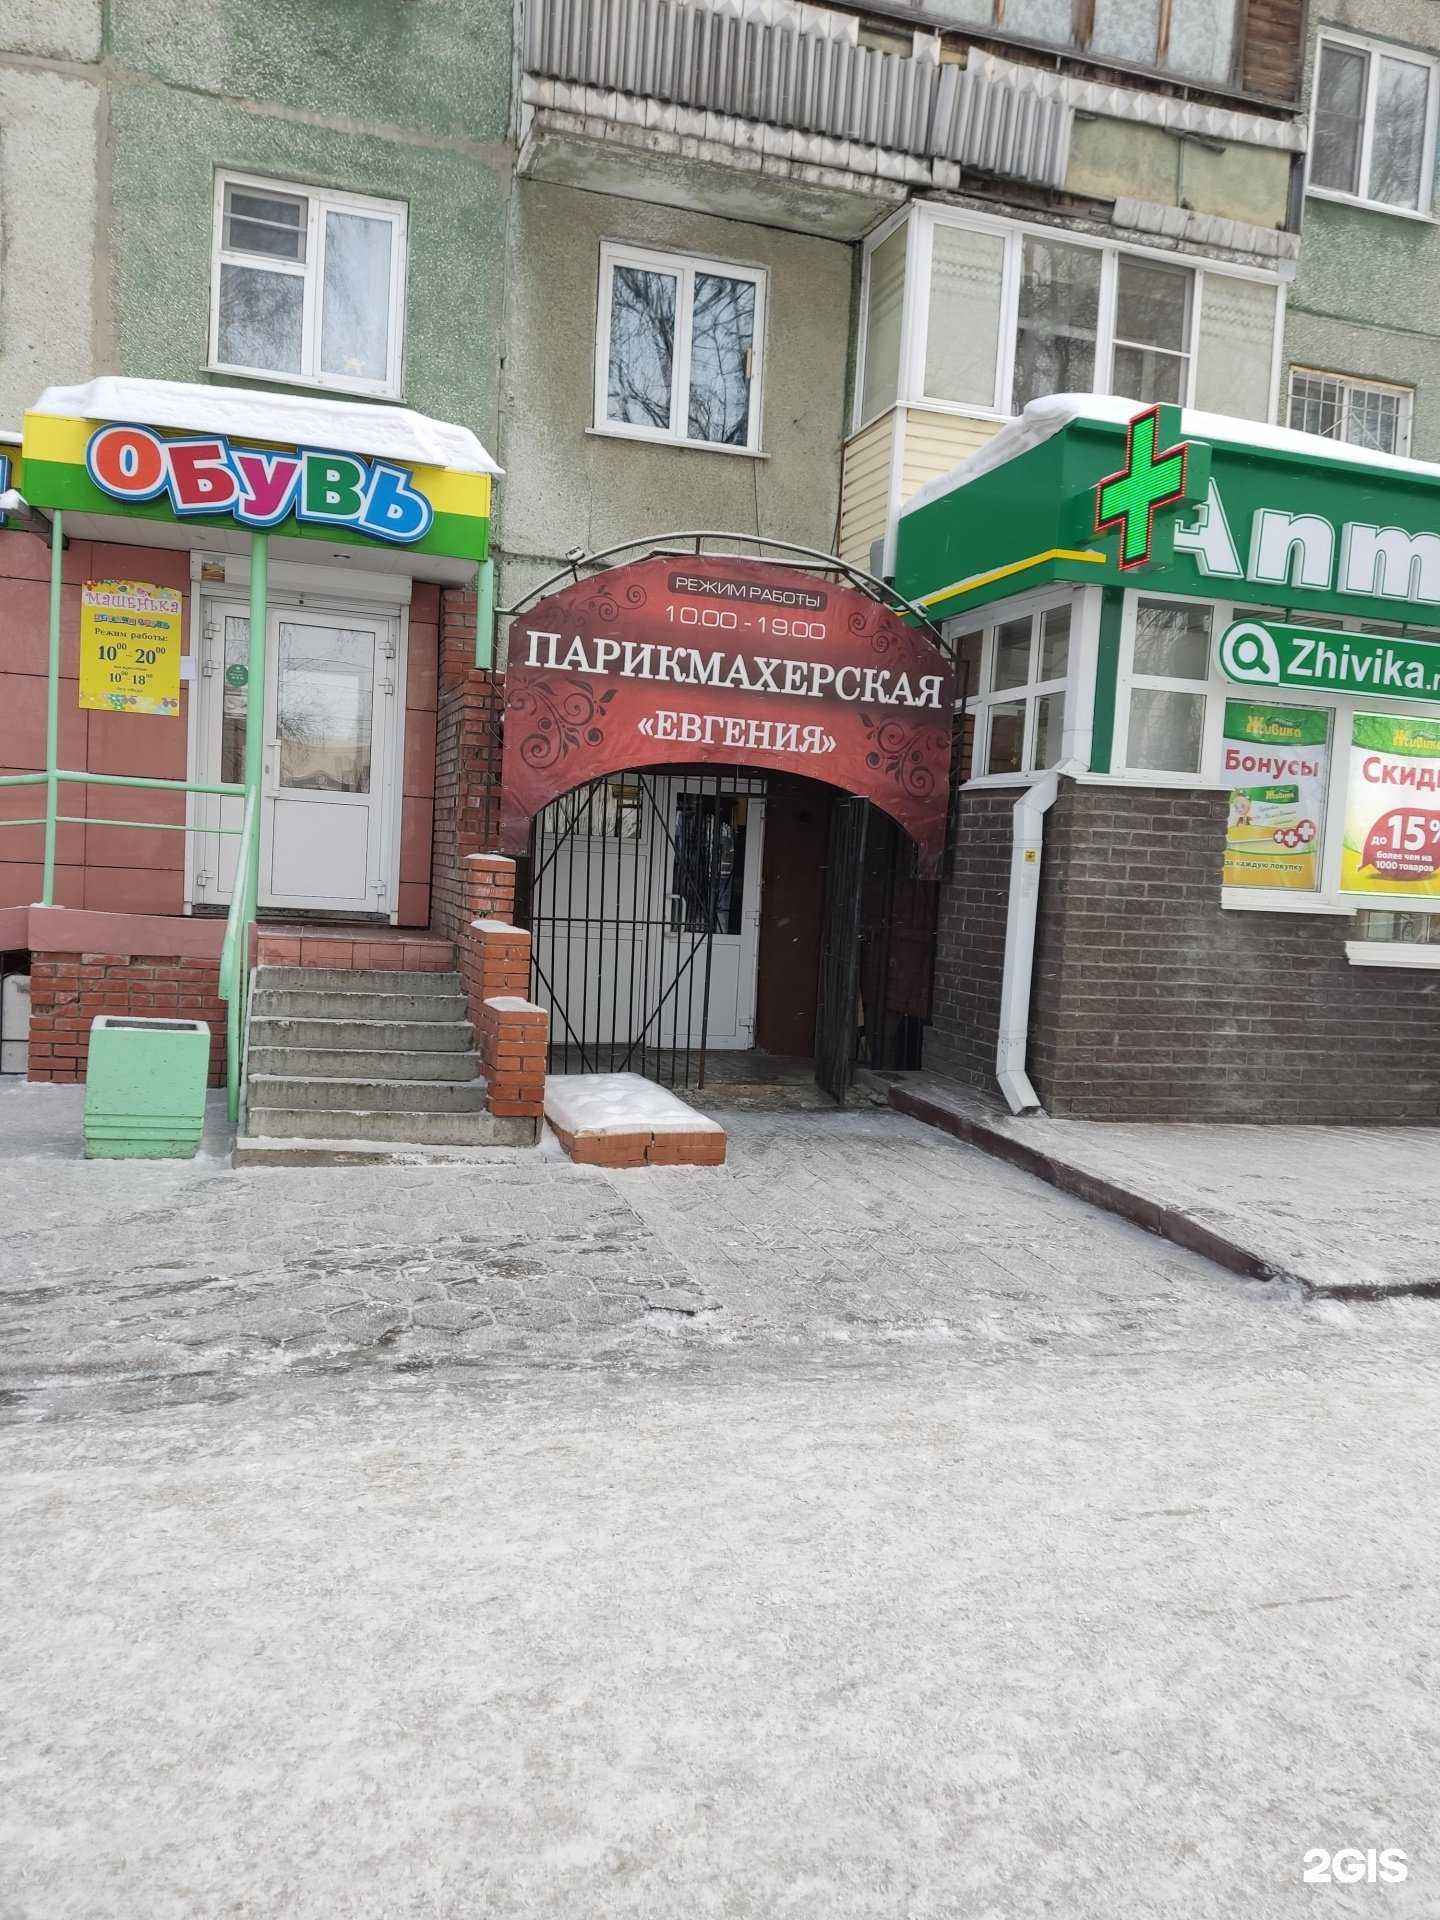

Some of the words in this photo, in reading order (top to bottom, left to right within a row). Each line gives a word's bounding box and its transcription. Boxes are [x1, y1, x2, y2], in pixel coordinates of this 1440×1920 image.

[91, 426, 430, 541] ОБУВЬ
[675, 576, 746, 597] РЕЖИМ
[750, 587, 820, 608] РАБОТЫ
[95, 627, 127, 638] Режим
[131, 632, 168, 642] работы:
[666, 605, 737, 629] 10.00
[758, 616, 826, 640] 19.00
[524, 630, 944, 709] ПАРИКМАХЕРСКАЯ
[638, 710, 837, 754] «ЕВГЕНИЯ»
[1225, 749, 1319, 780] Бонусы
[1363, 756, 1440, 792] Скид
[1371, 836, 1388, 846] до
[1376, 851, 1403, 861] более
[1376, 860, 1398, 870] 1000
[1399, 863, 1434, 873] товаров
